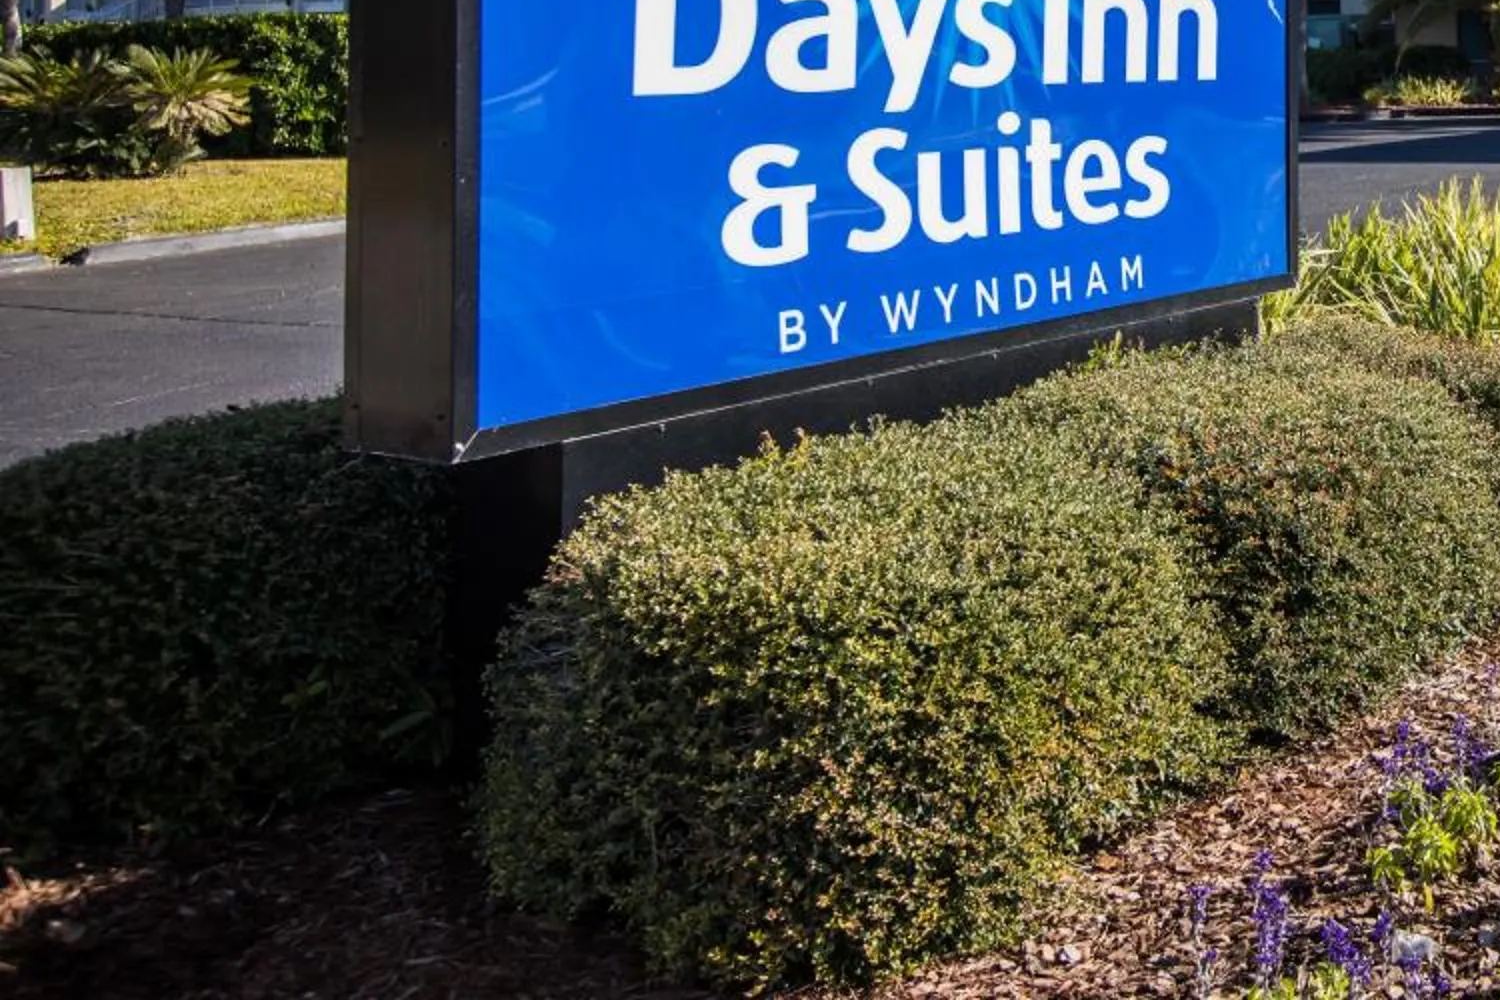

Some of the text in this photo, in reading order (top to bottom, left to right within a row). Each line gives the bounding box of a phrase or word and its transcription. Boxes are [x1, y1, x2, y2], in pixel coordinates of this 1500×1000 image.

[721, 110, 1170, 266] & Suites
[780, 254, 1146, 353] BY WYNDHAM
